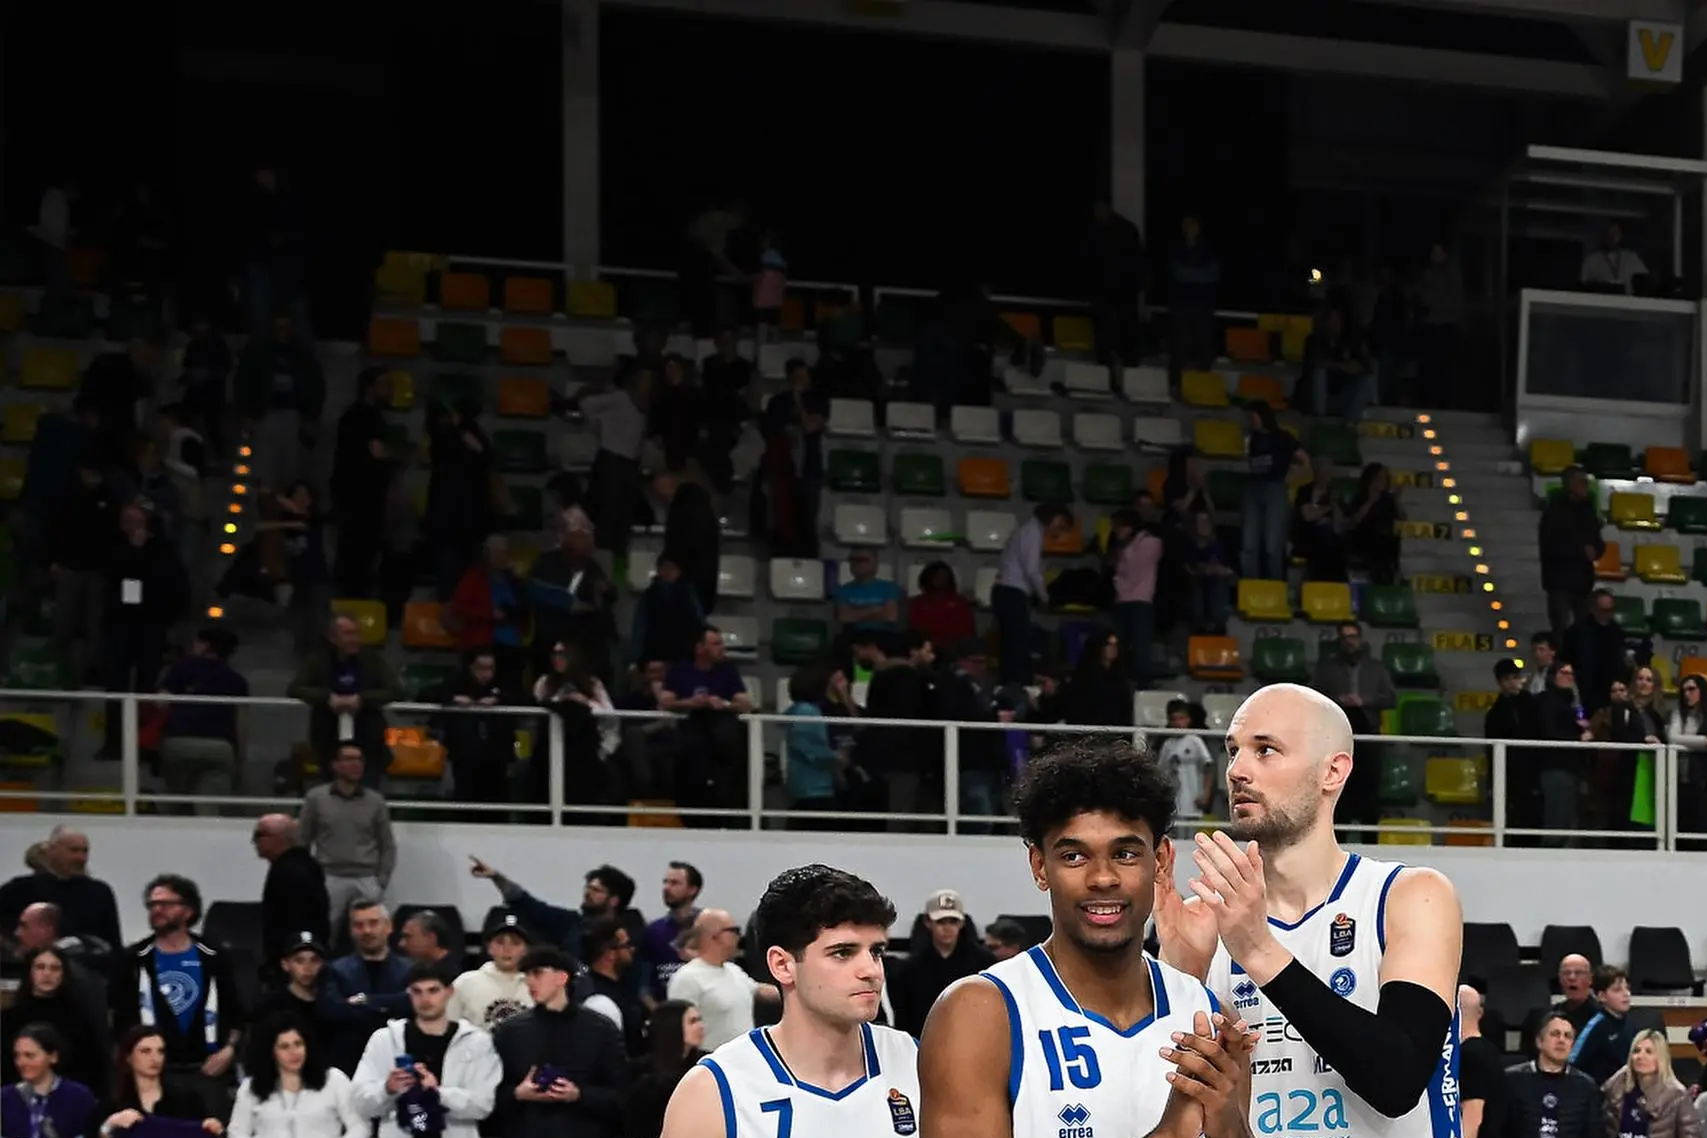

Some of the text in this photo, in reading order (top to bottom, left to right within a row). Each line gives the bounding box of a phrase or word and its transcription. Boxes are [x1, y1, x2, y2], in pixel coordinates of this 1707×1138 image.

[1638, 28, 1675, 73] V
[1038, 1025, 1101, 1091] 15
[1256, 1088, 1349, 1134] a2a
